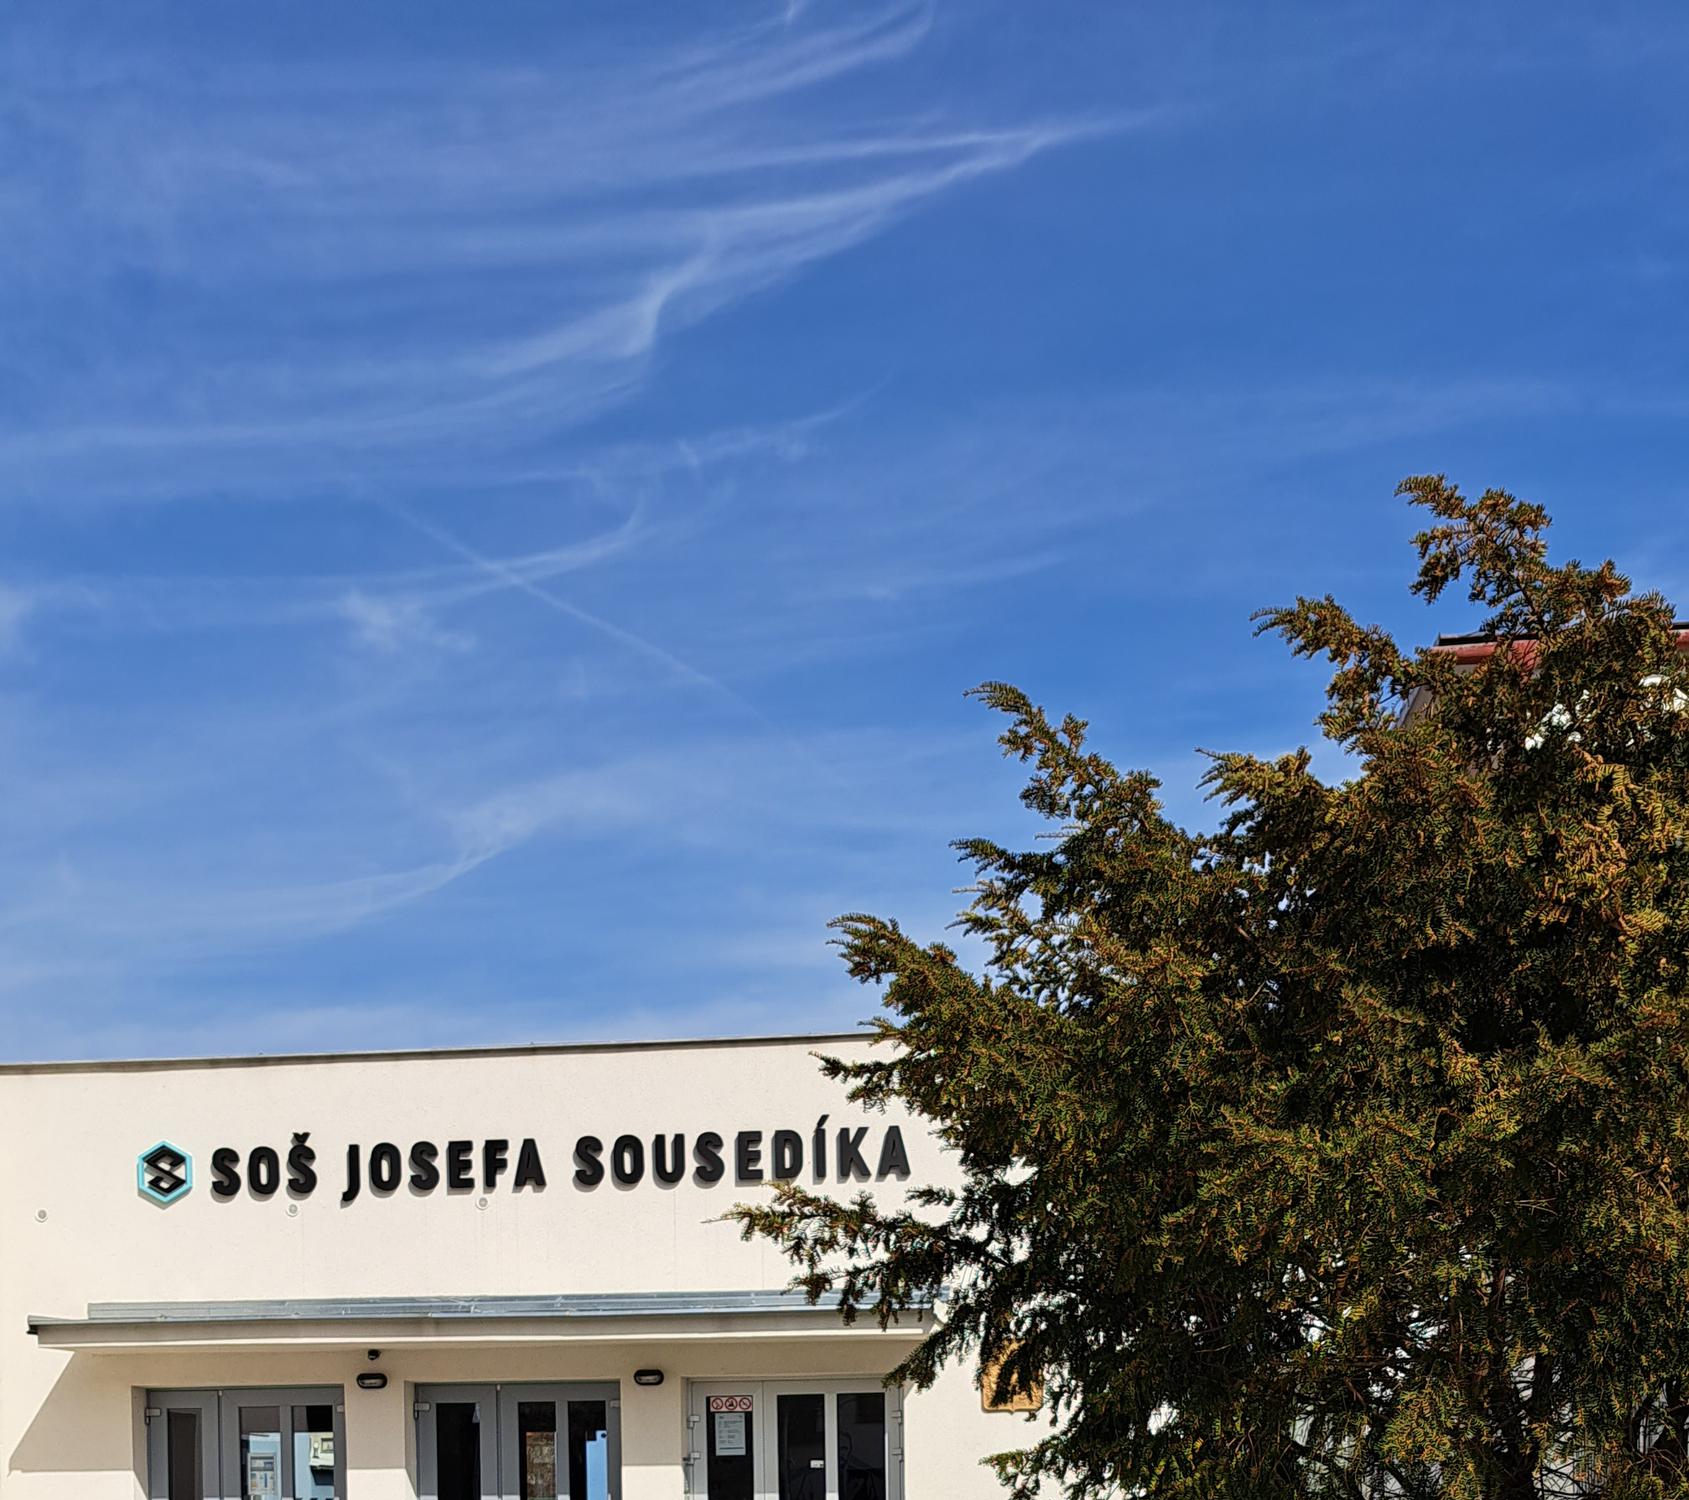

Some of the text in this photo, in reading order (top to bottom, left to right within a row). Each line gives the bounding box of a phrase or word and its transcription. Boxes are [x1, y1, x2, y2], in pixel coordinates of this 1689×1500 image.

[211, 1132, 318, 1197] SOŠ
[341, 1138, 545, 1208] JOSEFA
[574, 1114, 911, 1187] SOUSEDÍKA
